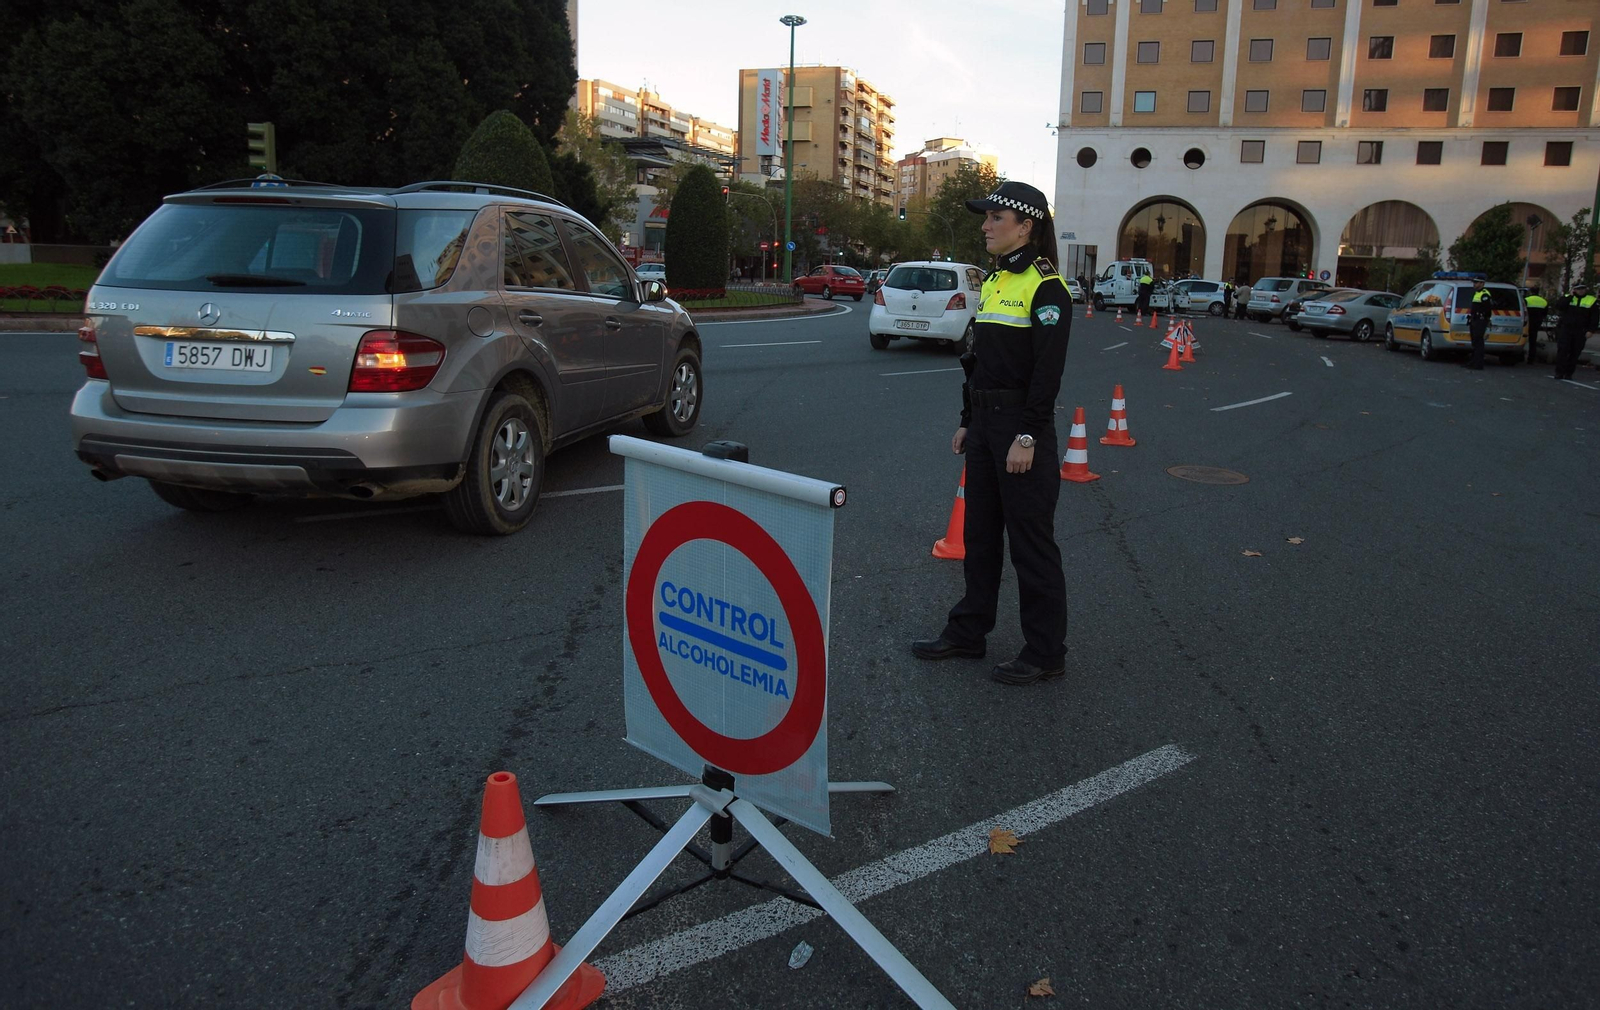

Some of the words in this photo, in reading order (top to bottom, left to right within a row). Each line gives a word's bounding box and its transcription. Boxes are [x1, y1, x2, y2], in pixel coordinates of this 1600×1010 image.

[761, 78, 771, 107] Markt
[761, 113, 770, 146] Media
[98, 301, 117, 310] 320
[999, 299, 1024, 308] POLICIA
[178, 345, 222, 365] 5857
[231, 347, 267, 368] DWJ
[660, 581, 785, 650] CONTROL
[658, 631, 790, 701] ALCOHOLEMIA
